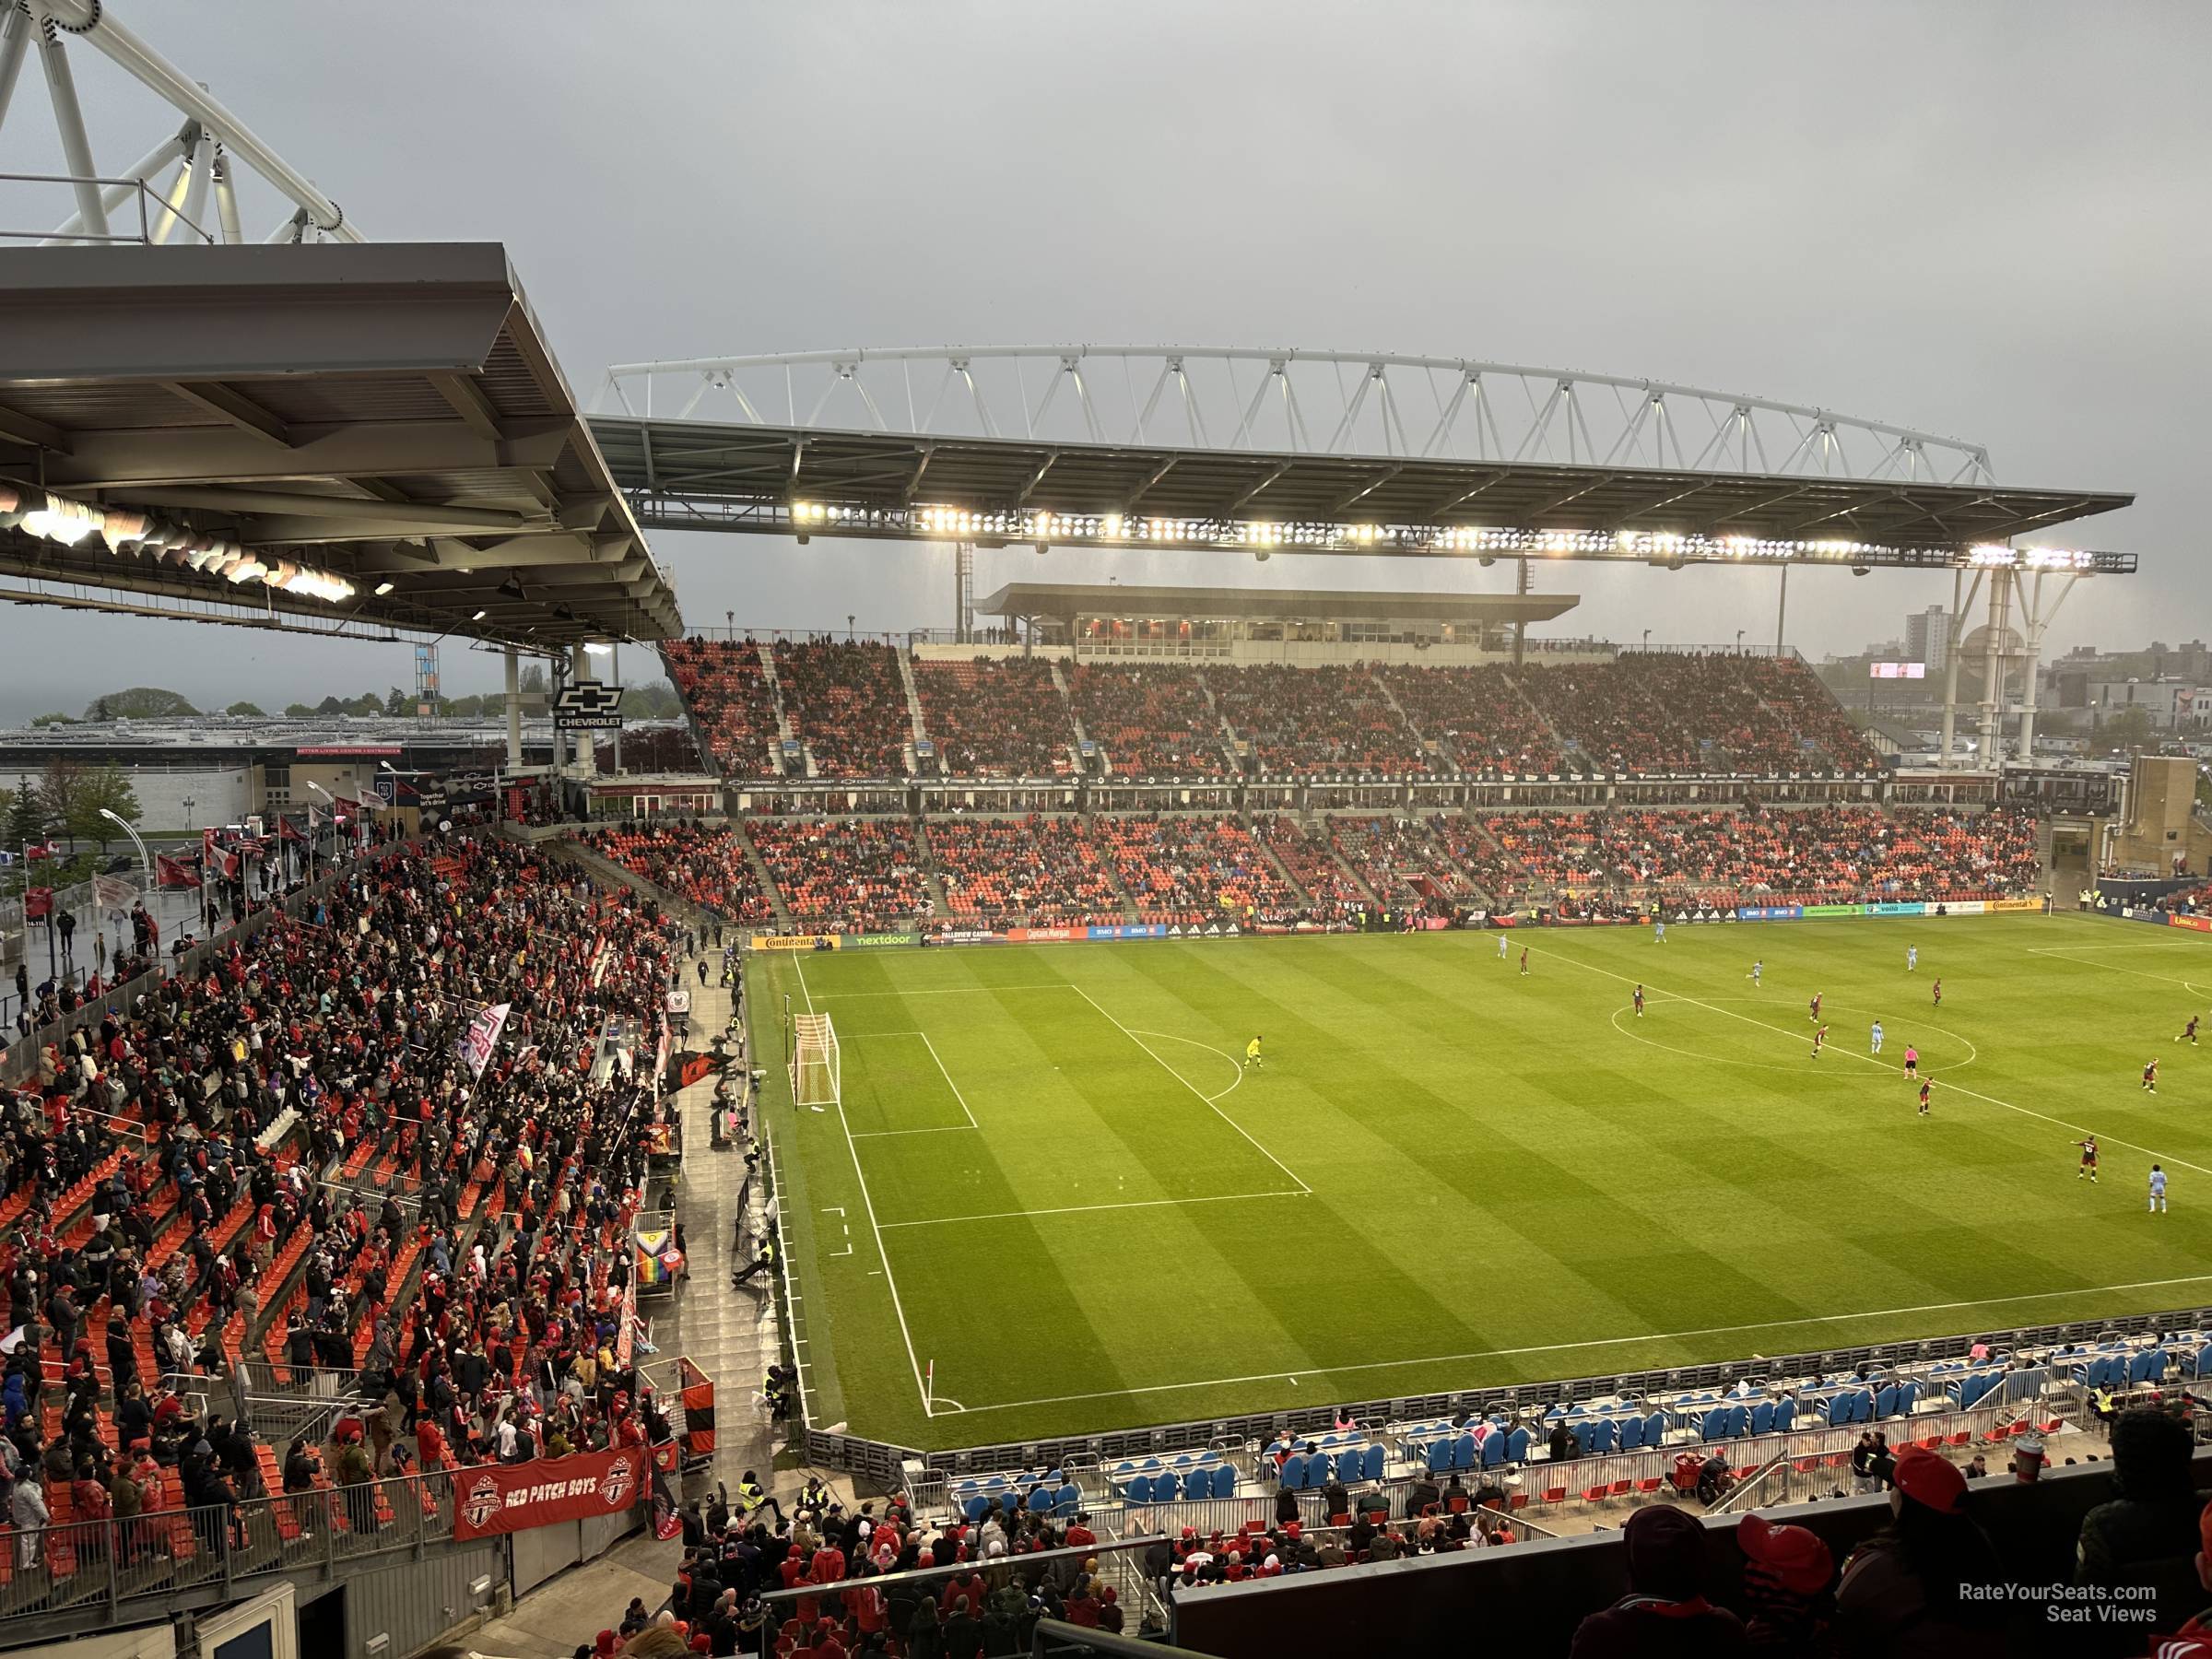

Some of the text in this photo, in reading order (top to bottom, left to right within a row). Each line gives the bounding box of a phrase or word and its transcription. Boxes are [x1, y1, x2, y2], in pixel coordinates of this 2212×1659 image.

[559, 717, 621, 727] CHEVROLET
[1993, 900, 2028, 911] Continental
[2174, 916, 2198, 927] Unico
[1026, 929, 1070, 938] Captain Morgan
[856, 934, 911, 946] nextdoor
[605, 1477, 632, 1488] TORONTO
[505, 1477, 597, 1508] RED PATCH BOYS
[465, 1498, 498, 1509] TORONTO
